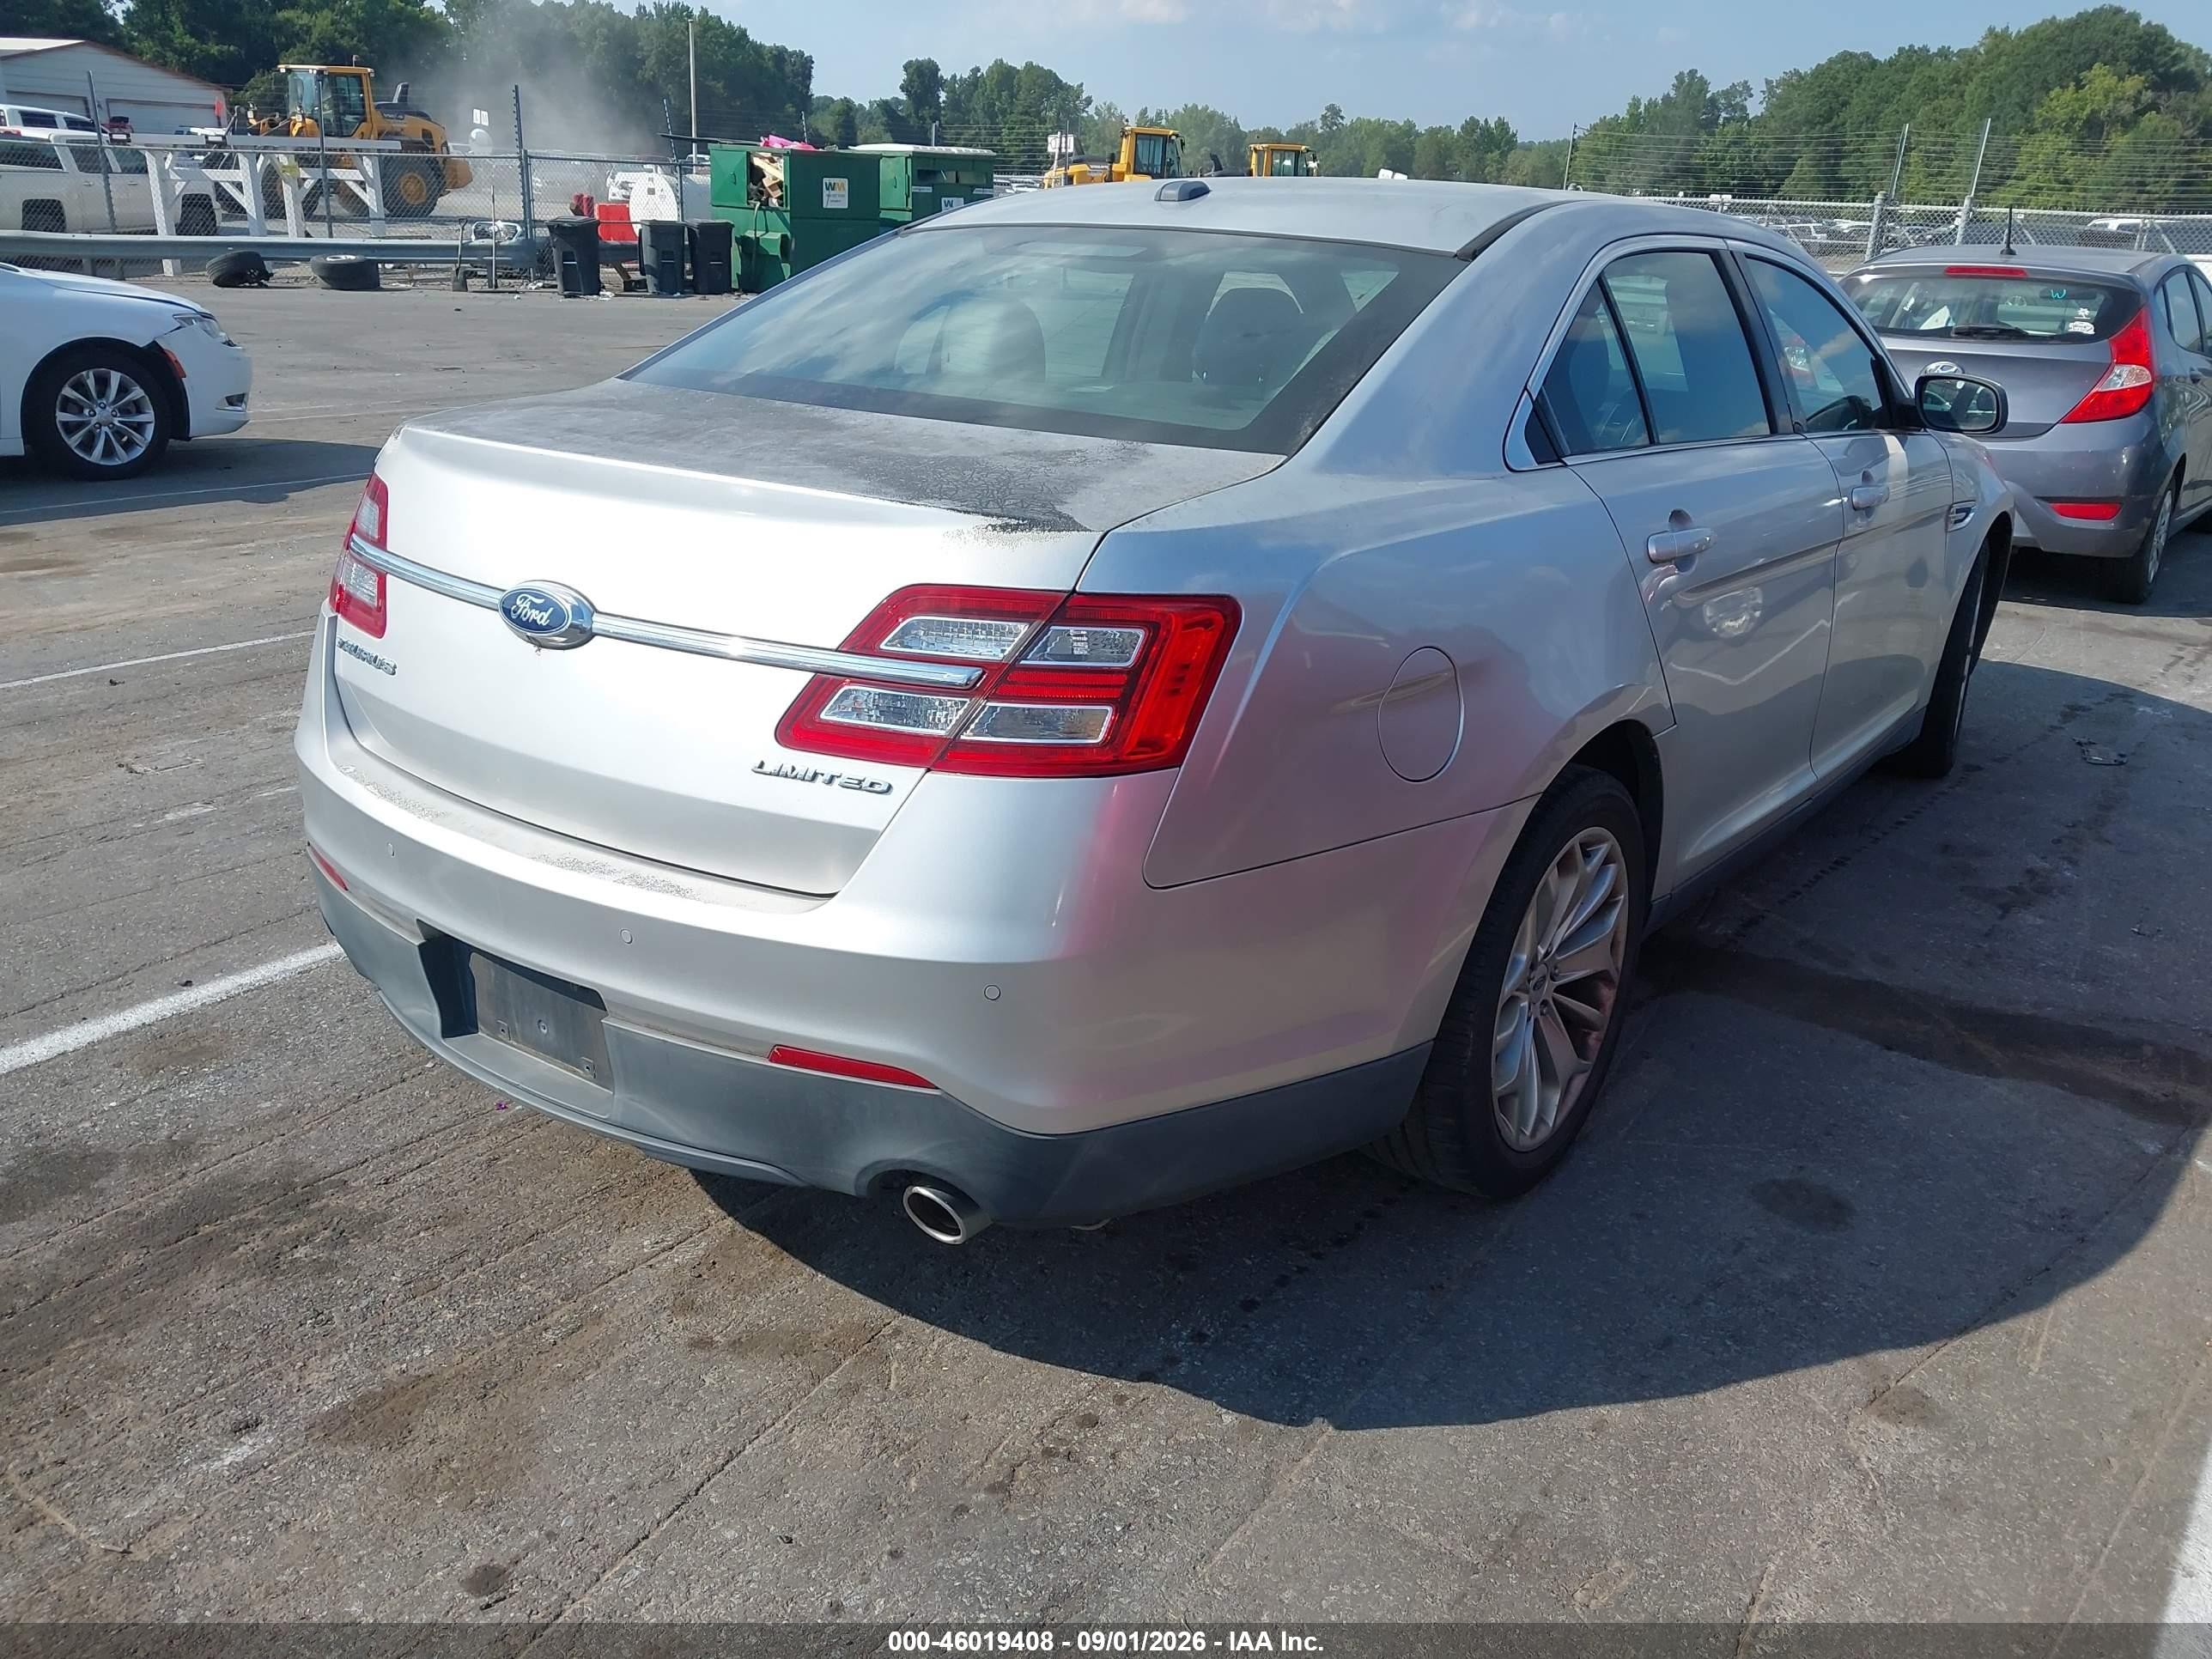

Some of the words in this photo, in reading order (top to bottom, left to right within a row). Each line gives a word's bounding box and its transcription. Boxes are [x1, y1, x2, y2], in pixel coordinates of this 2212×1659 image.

[824, 181, 846, 191] WM
[511, 593, 554, 626] Ford
[750, 760, 894, 795] LIMITED
